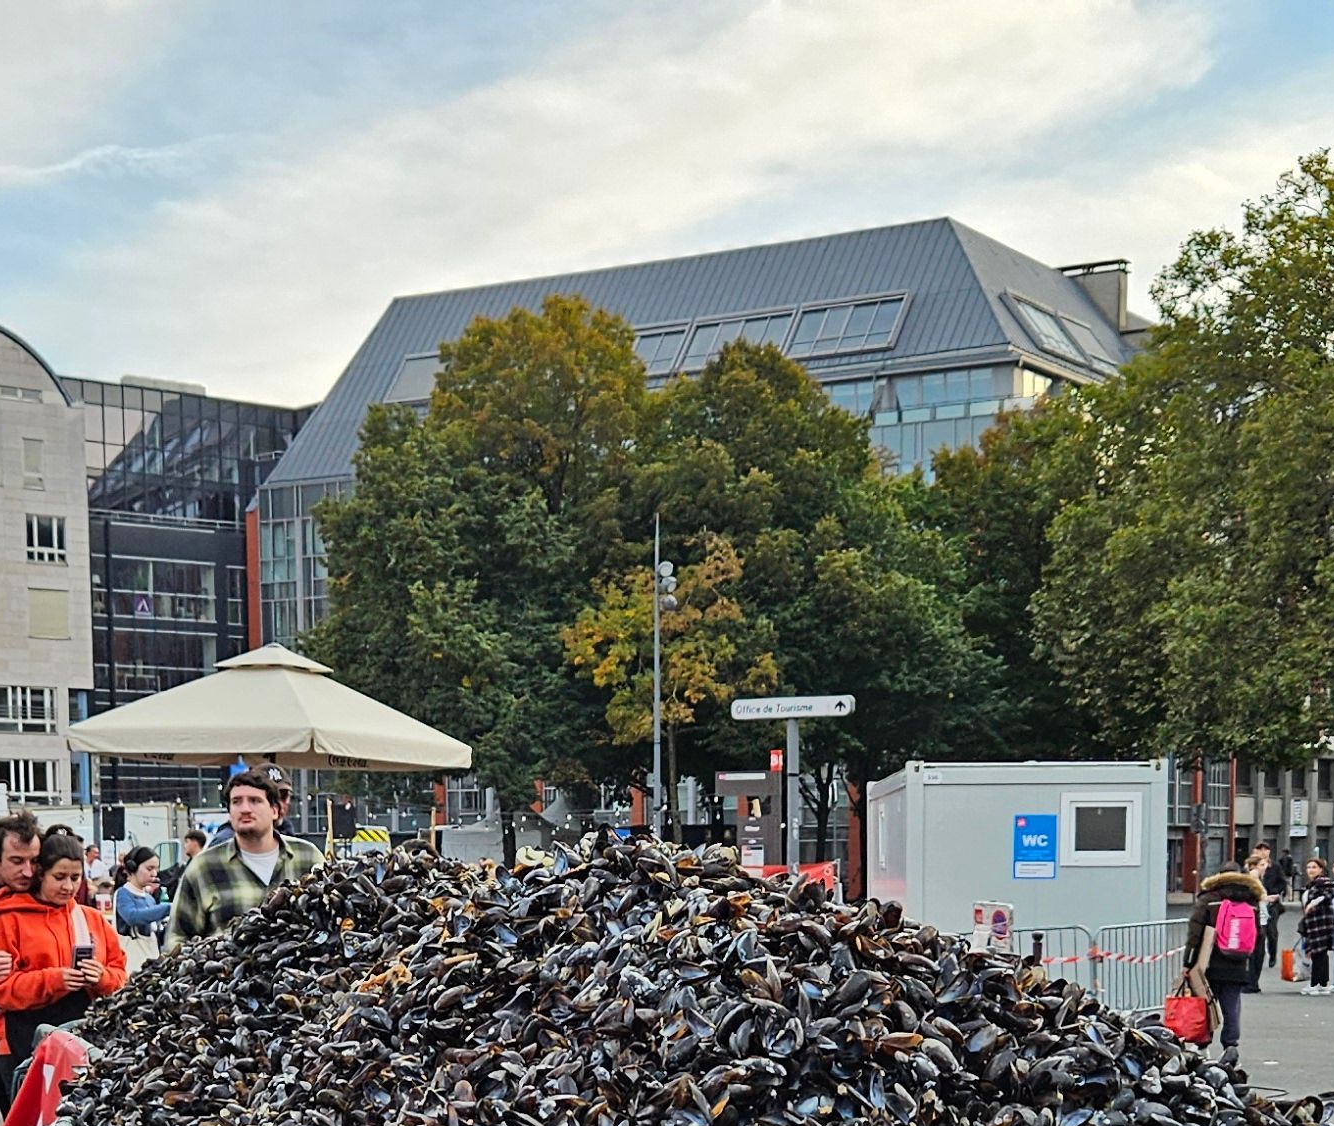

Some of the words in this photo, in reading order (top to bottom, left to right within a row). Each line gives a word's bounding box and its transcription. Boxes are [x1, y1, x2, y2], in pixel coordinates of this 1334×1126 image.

[736, 704, 761, 714] Office
[763, 704, 773, 713] de
[776, 703, 813, 713] Tourisme
[1022, 834, 1048, 847] WC
